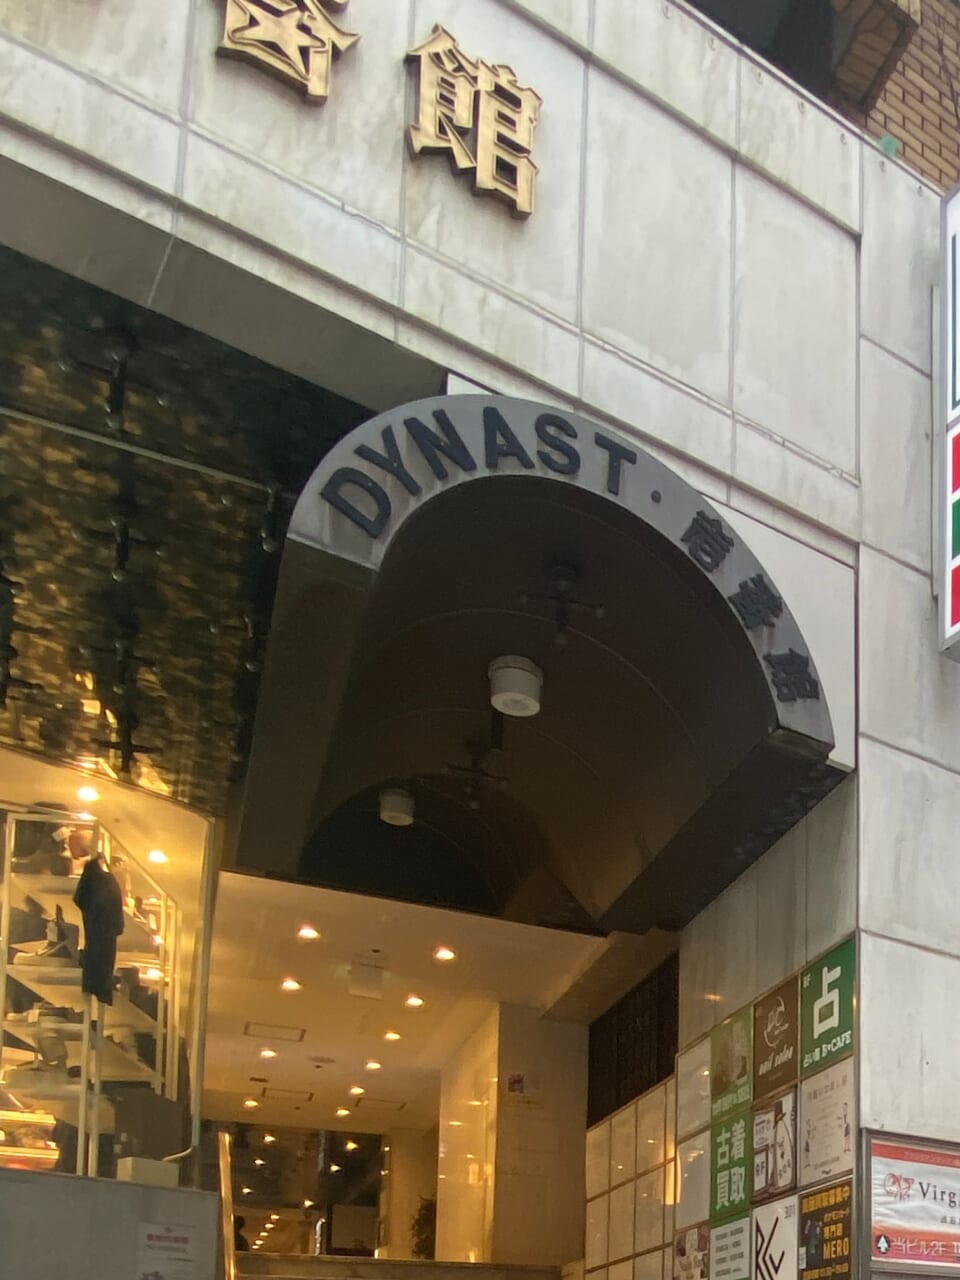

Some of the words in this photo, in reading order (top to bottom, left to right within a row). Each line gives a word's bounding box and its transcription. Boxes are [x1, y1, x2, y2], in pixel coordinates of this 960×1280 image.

[320, 406, 637, 539] DYNAST
[813, 966, 842, 1039] 占
[716, 1118, 746, 1169] 古着
[715, 1166, 746, 1210] 買取
[822, 1237, 850, 1260] MERO
